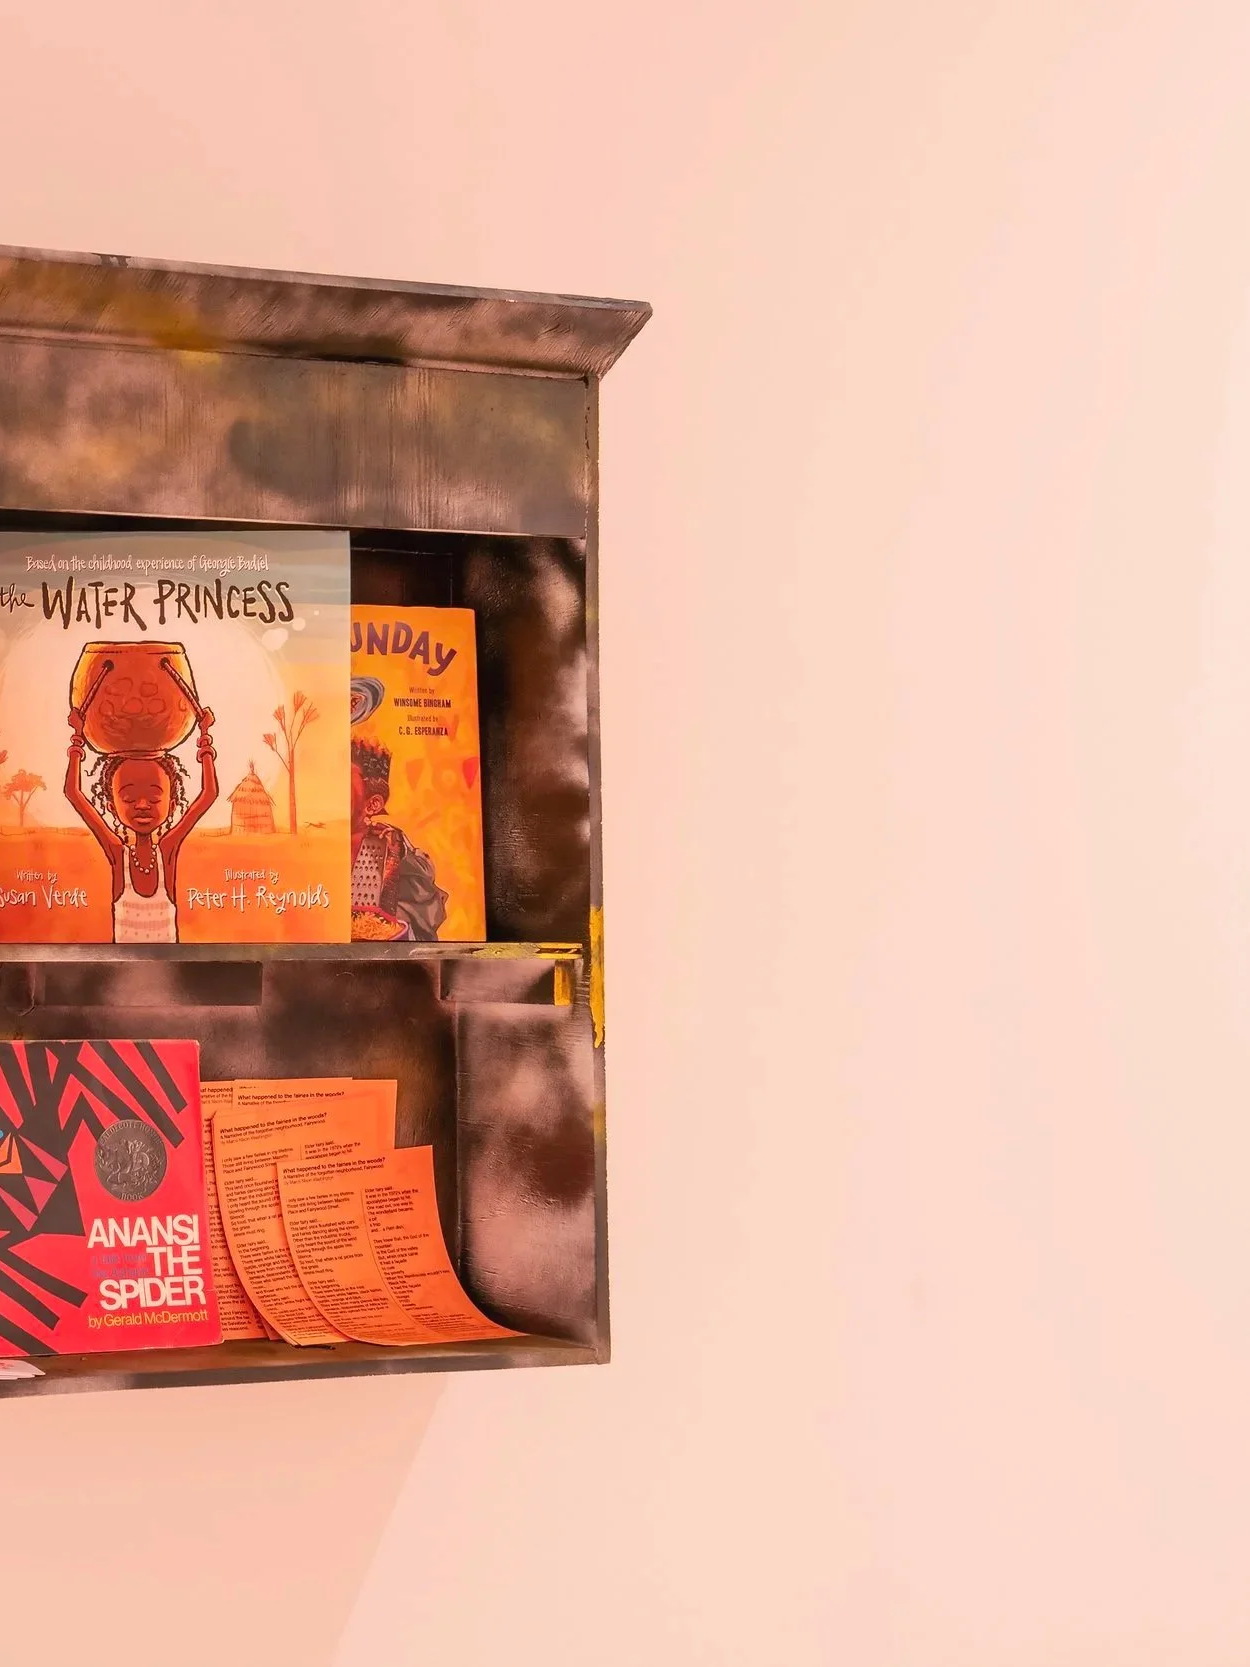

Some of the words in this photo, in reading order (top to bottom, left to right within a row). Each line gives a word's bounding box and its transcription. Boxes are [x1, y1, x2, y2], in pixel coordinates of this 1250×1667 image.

[25, 554, 57, 572] Based
[57, 560, 69, 570] on
[70, 555, 85, 571] the
[88, 554, 132, 571] childhood
[136, 556, 185, 576] experience
[187, 555, 197, 571] of
[199, 554, 236, 577] Georgie
[237, 554, 270, 571] Badiel
[41, 576, 147, 632] WATER
[153, 578, 294, 625] PRINCESS
[409, 686, 428, 694] Written
[429, 687, 435, 695] by
[394, 698, 422, 708] WINSOME
[423, 699, 451, 708] BINGHAM
[407, 714, 432, 722] Illustrated
[432, 715, 439, 723] by
[414, 726, 448, 737] ESPERANZA
[16, 868, 44, 881] Written
[47, 870, 58, 883] by
[224, 868, 266, 882] Illustrated
[269, 869, 279, 884] by
[41, 884, 88, 909] Verde
[187, 886, 227, 909] Peter
[231, 883, 251, 912] H.
[255, 883, 330, 915] Reynolds
[252, 1093, 277, 1101] happened
[220, 1126, 233, 1134] What
[236, 1122, 259, 1133] happened
[267, 1119, 275, 1127] the
[275, 1117, 292, 1125] fairies
[307, 1112, 327, 1121] woods?
[296, 1164, 320, 1173] happened
[366, 1156, 386, 1164] woods?
[87, 1213, 200, 1248] ANANSI
[146, 1245, 203, 1276] THE
[99, 1275, 207, 1311] SPIDER
[88, 1315, 103, 1329] by
[103, 1312, 143, 1327] Gerald
[144, 1309, 209, 1325] McDermott
